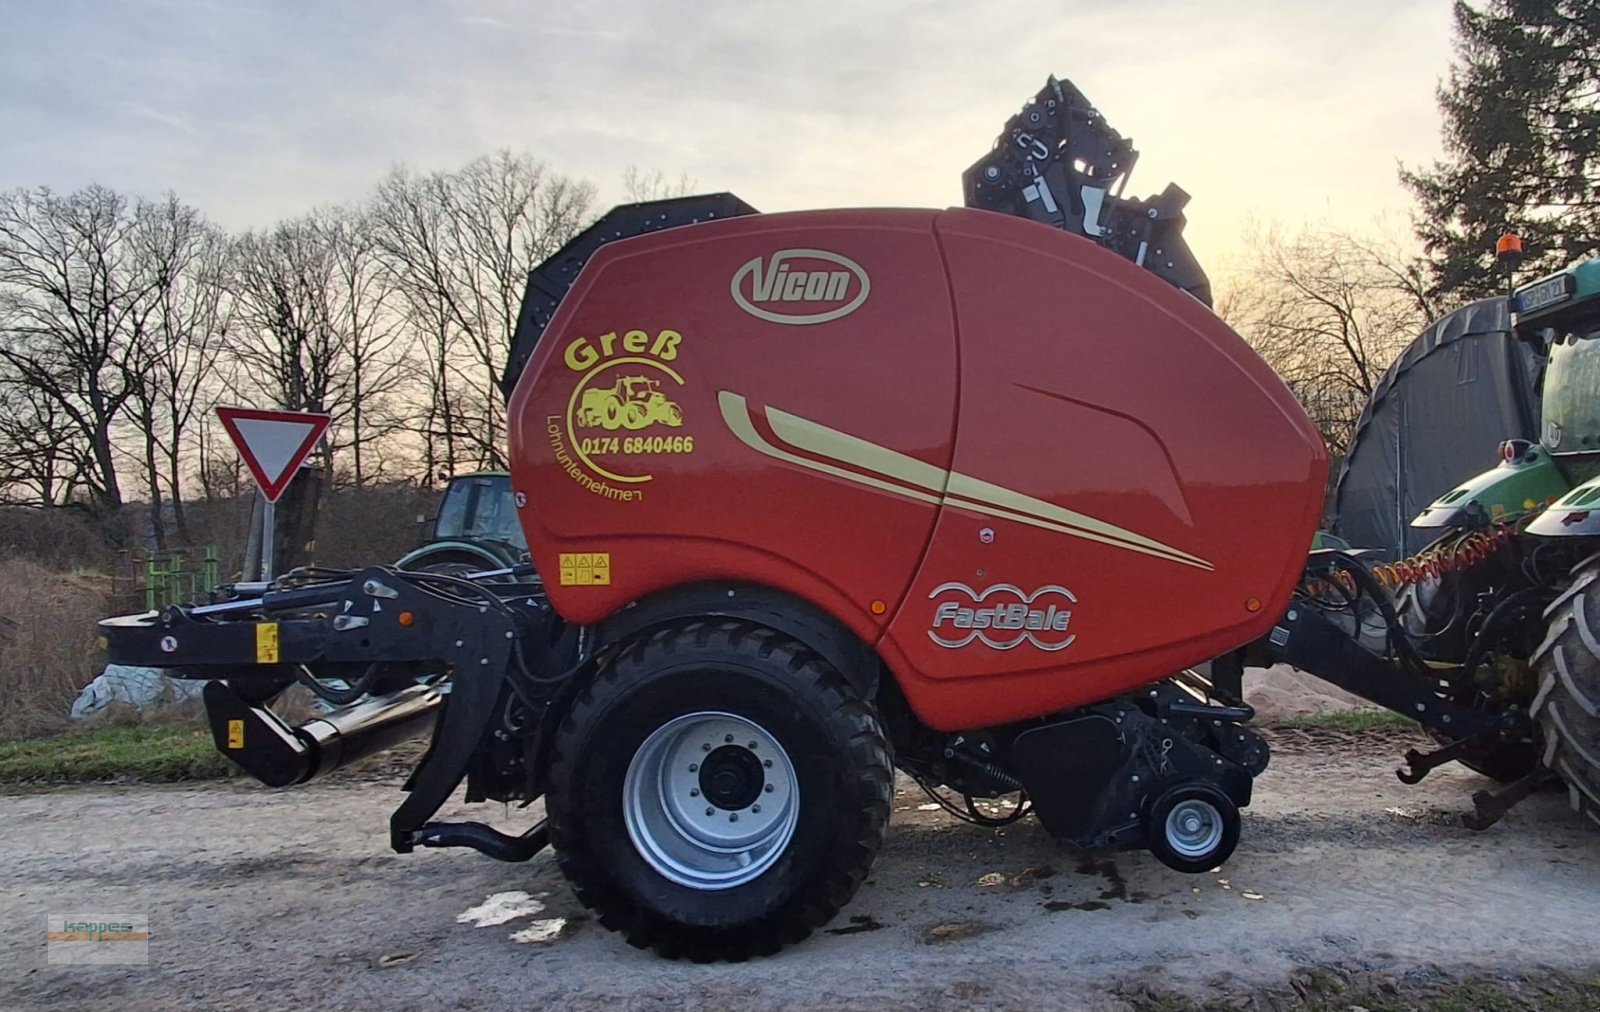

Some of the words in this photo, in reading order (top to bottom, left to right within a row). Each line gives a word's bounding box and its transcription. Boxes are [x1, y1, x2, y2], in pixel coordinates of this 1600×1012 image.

[752, 253, 850, 302] Vicon
[564, 329, 682, 371] Greß
[546, 415, 643, 501] Lohnunternehmen
[581, 437, 620, 455] 0174
[623, 436, 694, 454] 6840466
[932, 601, 1073, 632] FastBale
